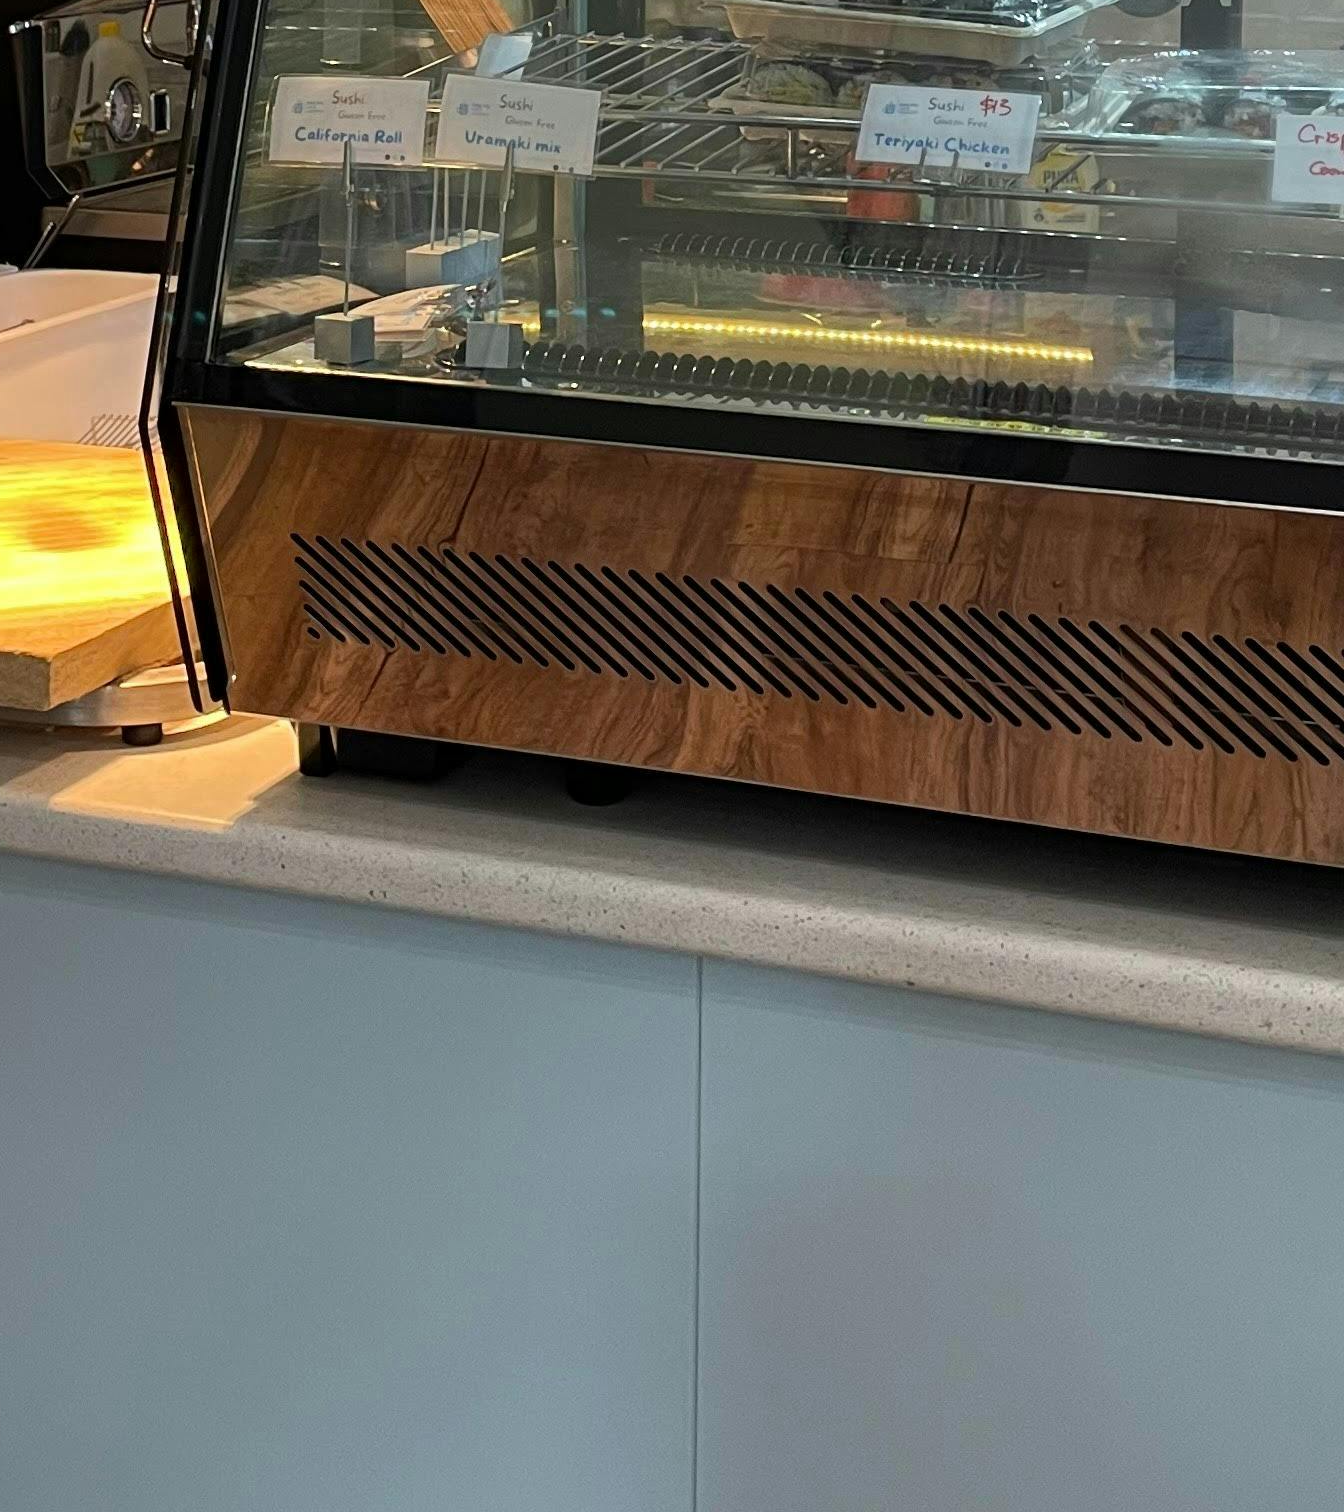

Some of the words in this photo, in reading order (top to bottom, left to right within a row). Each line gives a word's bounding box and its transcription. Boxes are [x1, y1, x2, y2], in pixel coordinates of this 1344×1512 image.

[332, 90, 365, 105] Sushi
[499, 94, 533, 111] Sushi
[928, 97, 965, 112] Sushi
[979, 94, 1012, 117] $13
[295, 127, 370, 143] California
[374, 129, 402, 144] Roll
[465, 129, 531, 150] Uramaki
[535, 141, 561, 154] mix
[874, 133, 939, 153] Teriyaki
[944, 137, 1010, 155] Chicken
